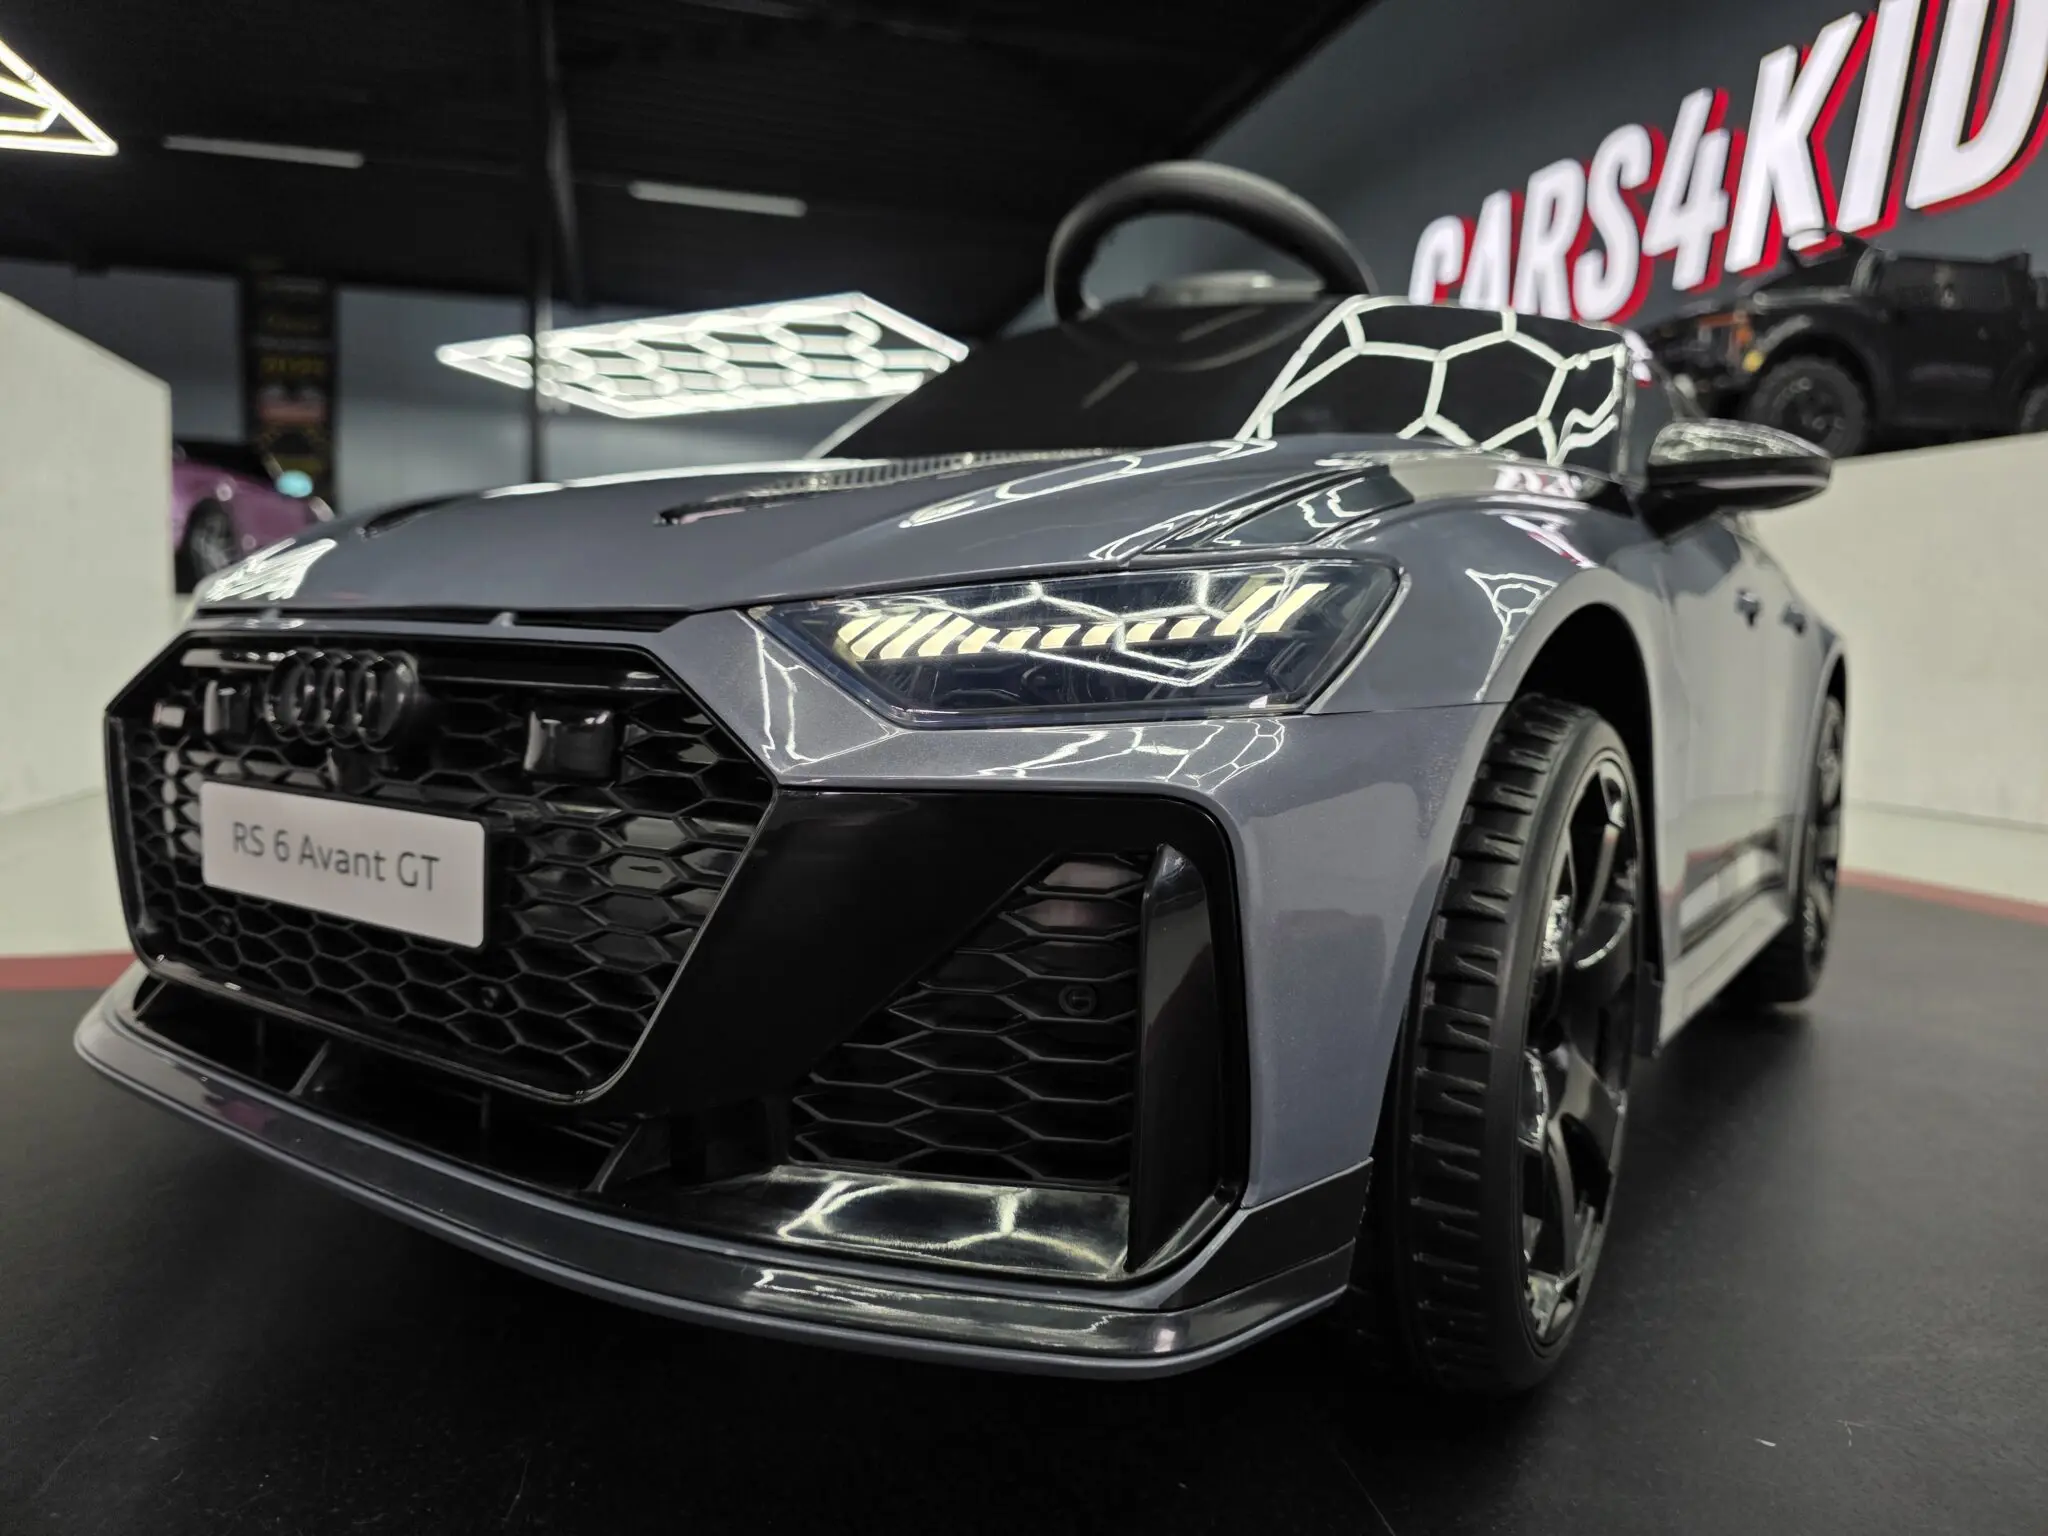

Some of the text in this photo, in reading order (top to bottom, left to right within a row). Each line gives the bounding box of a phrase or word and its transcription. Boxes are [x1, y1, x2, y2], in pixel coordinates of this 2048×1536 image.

[231, 820, 441, 892] RS 6 Avant GT
